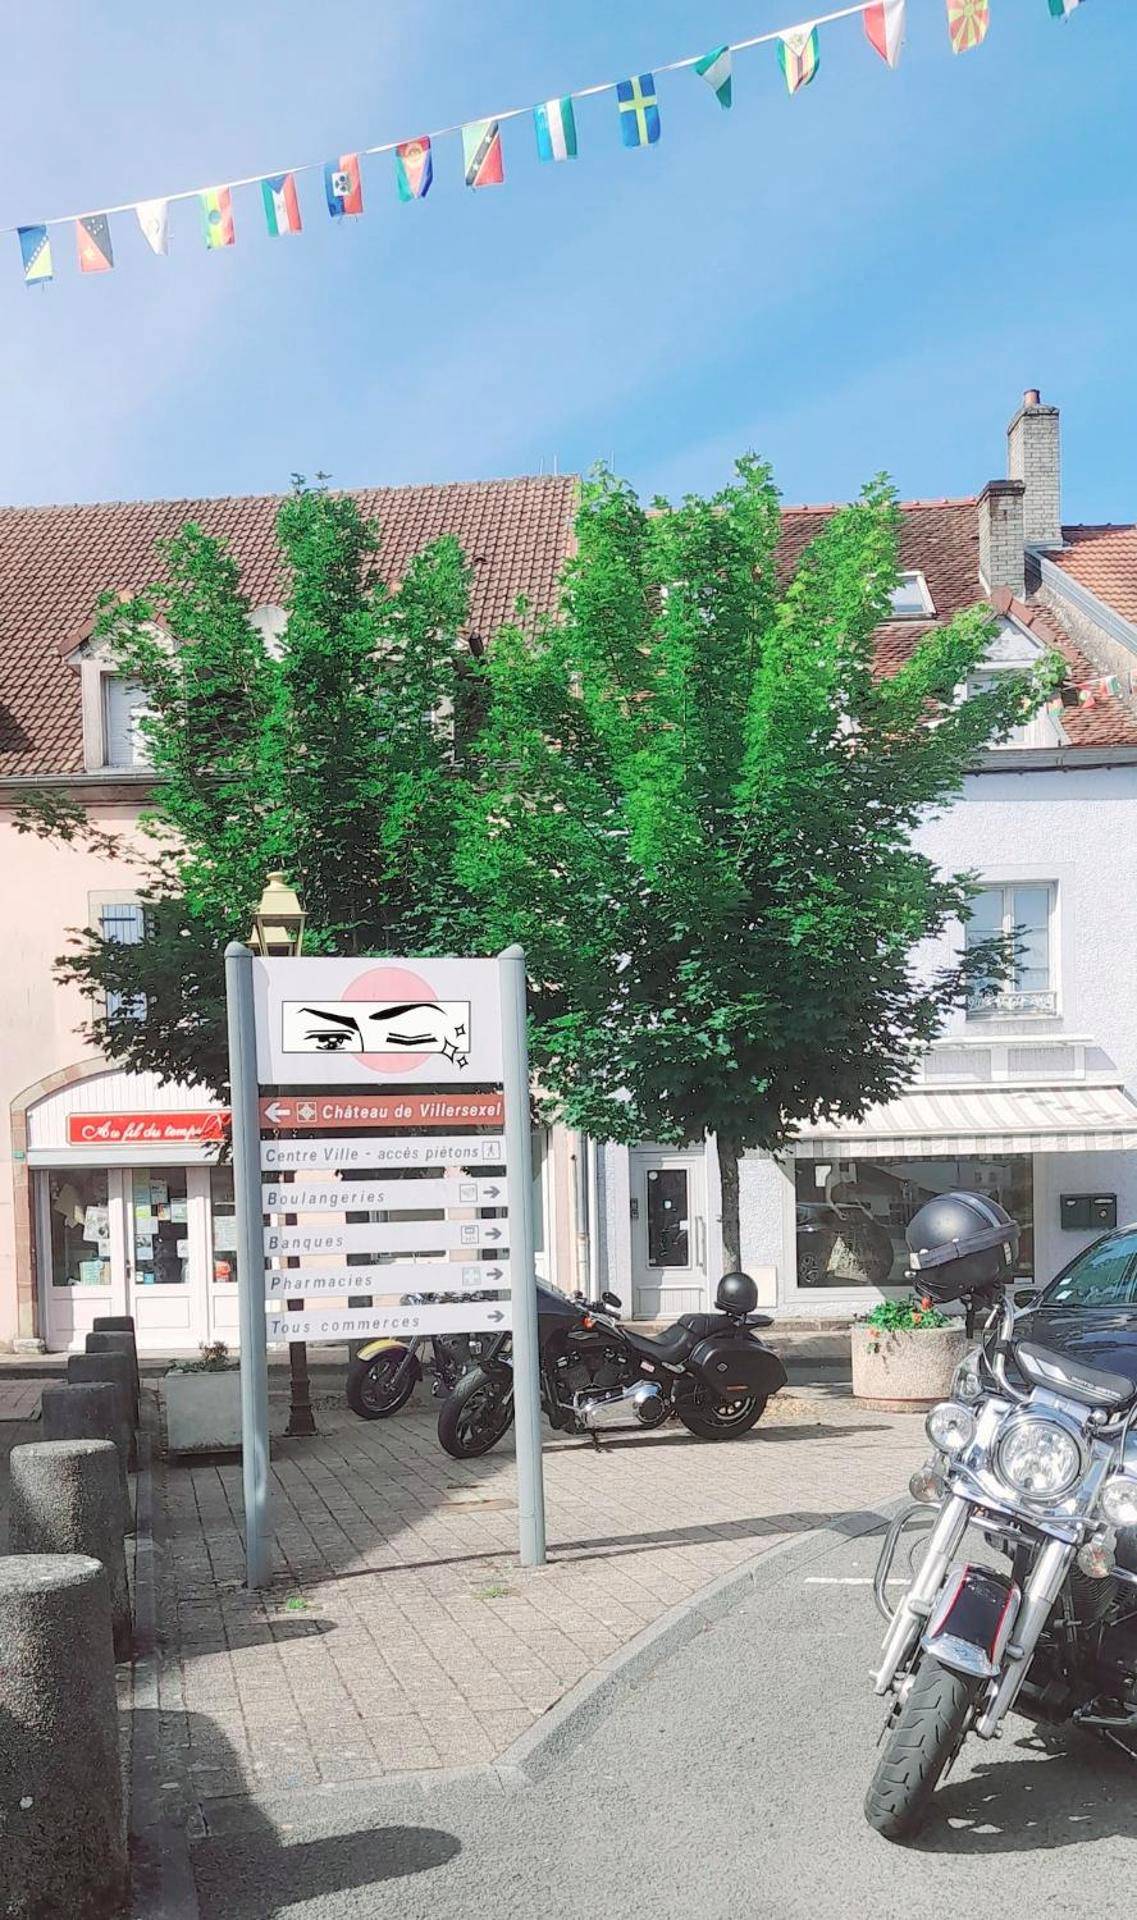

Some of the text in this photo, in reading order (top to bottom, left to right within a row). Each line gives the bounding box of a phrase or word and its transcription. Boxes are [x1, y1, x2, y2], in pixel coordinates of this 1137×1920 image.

[322, 1101, 502, 1119] Château de Villersexel
[82, 1120, 121, 1139] Au
[120, 1121, 143, 1143] fil
[143, 1122, 161, 1138] du
[266, 1148, 317, 1163] Centre
[324, 1147, 359, 1161] Ville
[268, 1191, 385, 1208] Boulangeries
[269, 1236, 344, 1251] Banques
[270, 1275, 373, 1291] Pharmacies
[271, 1316, 420, 1335] Tous commerces
